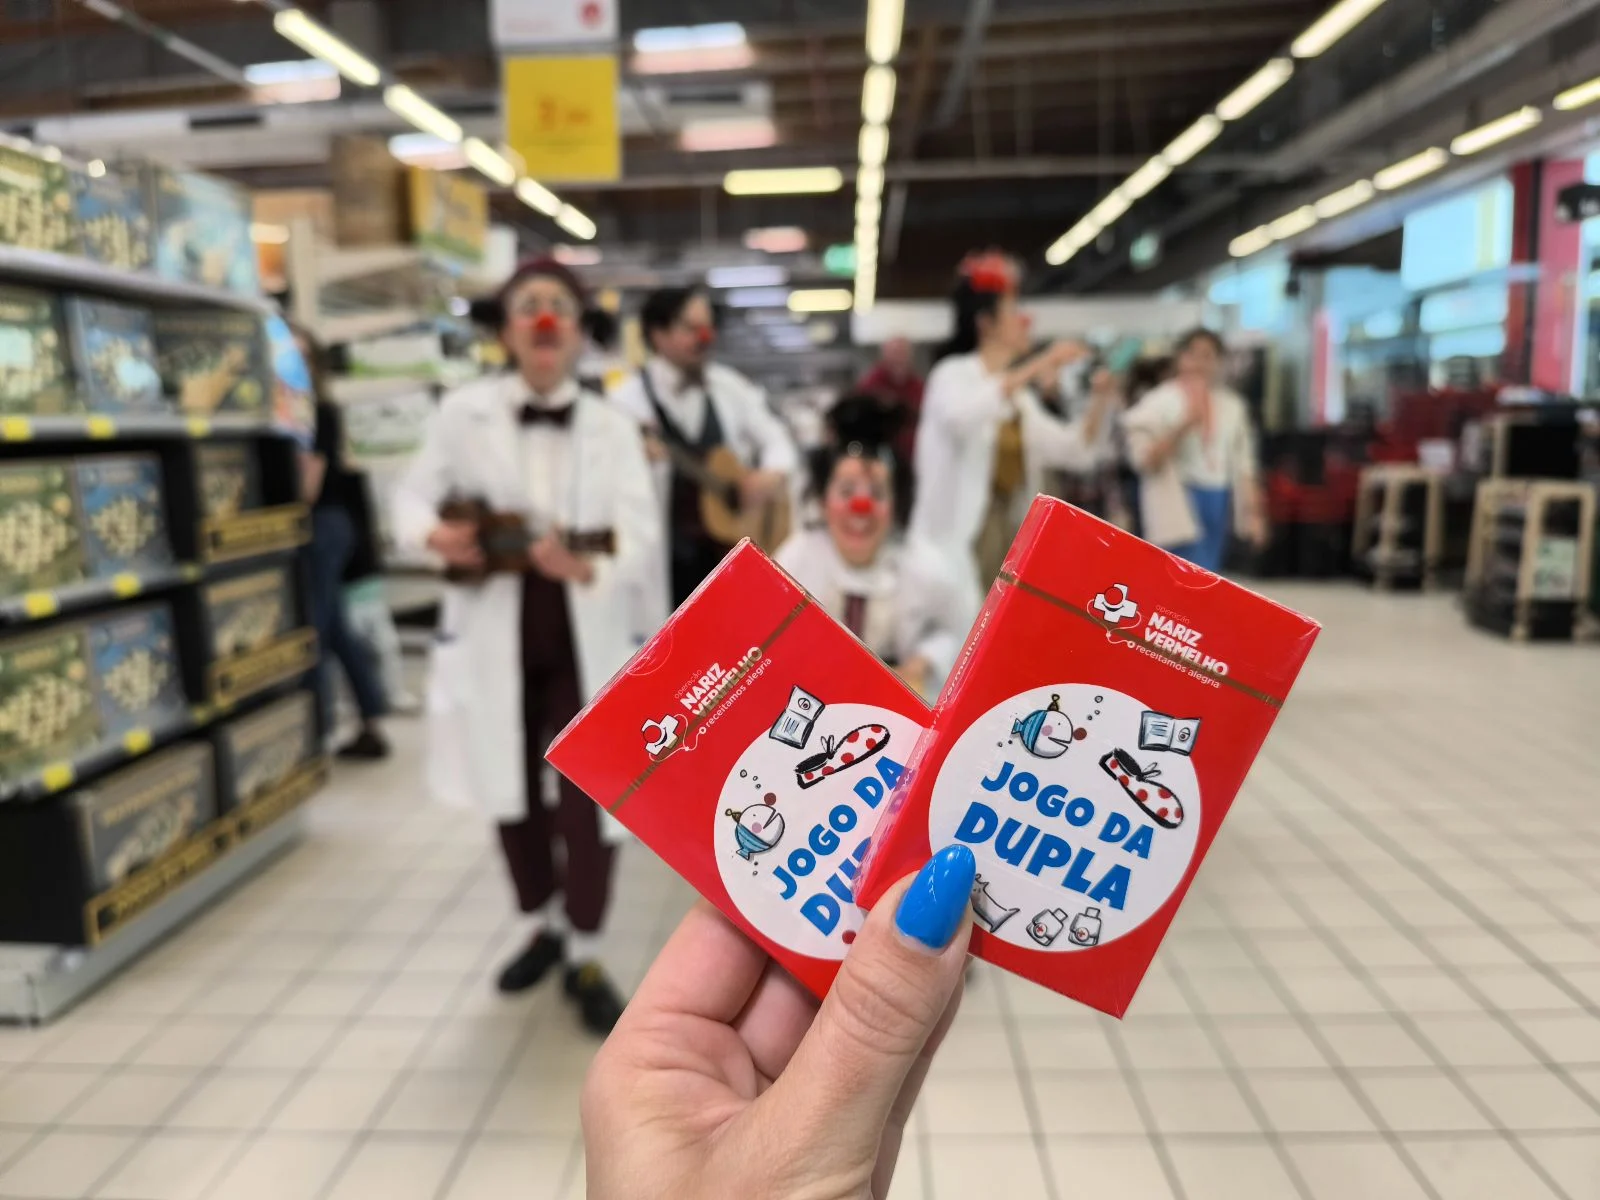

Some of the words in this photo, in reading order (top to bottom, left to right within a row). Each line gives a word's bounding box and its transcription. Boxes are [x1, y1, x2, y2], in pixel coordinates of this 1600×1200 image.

[1144, 627, 1229, 676] VERMELHO
[1147, 611, 1202, 647] NARIZ
[680, 662, 726, 711] NARIZ
[691, 646, 762, 717] VERMELHO
[705, 685, 747, 728] receitamos
[745, 658, 772, 686] alegria
[1136, 643, 1187, 674] receitamos
[1187, 666, 1221, 689] alegria
[772, 804, 857, 900] JOGO
[853, 756, 906, 809] DA
[980, 761, 1095, 827] JOGO
[1097, 811, 1154, 860] DA
[954, 801, 1132, 911] DUPLA
